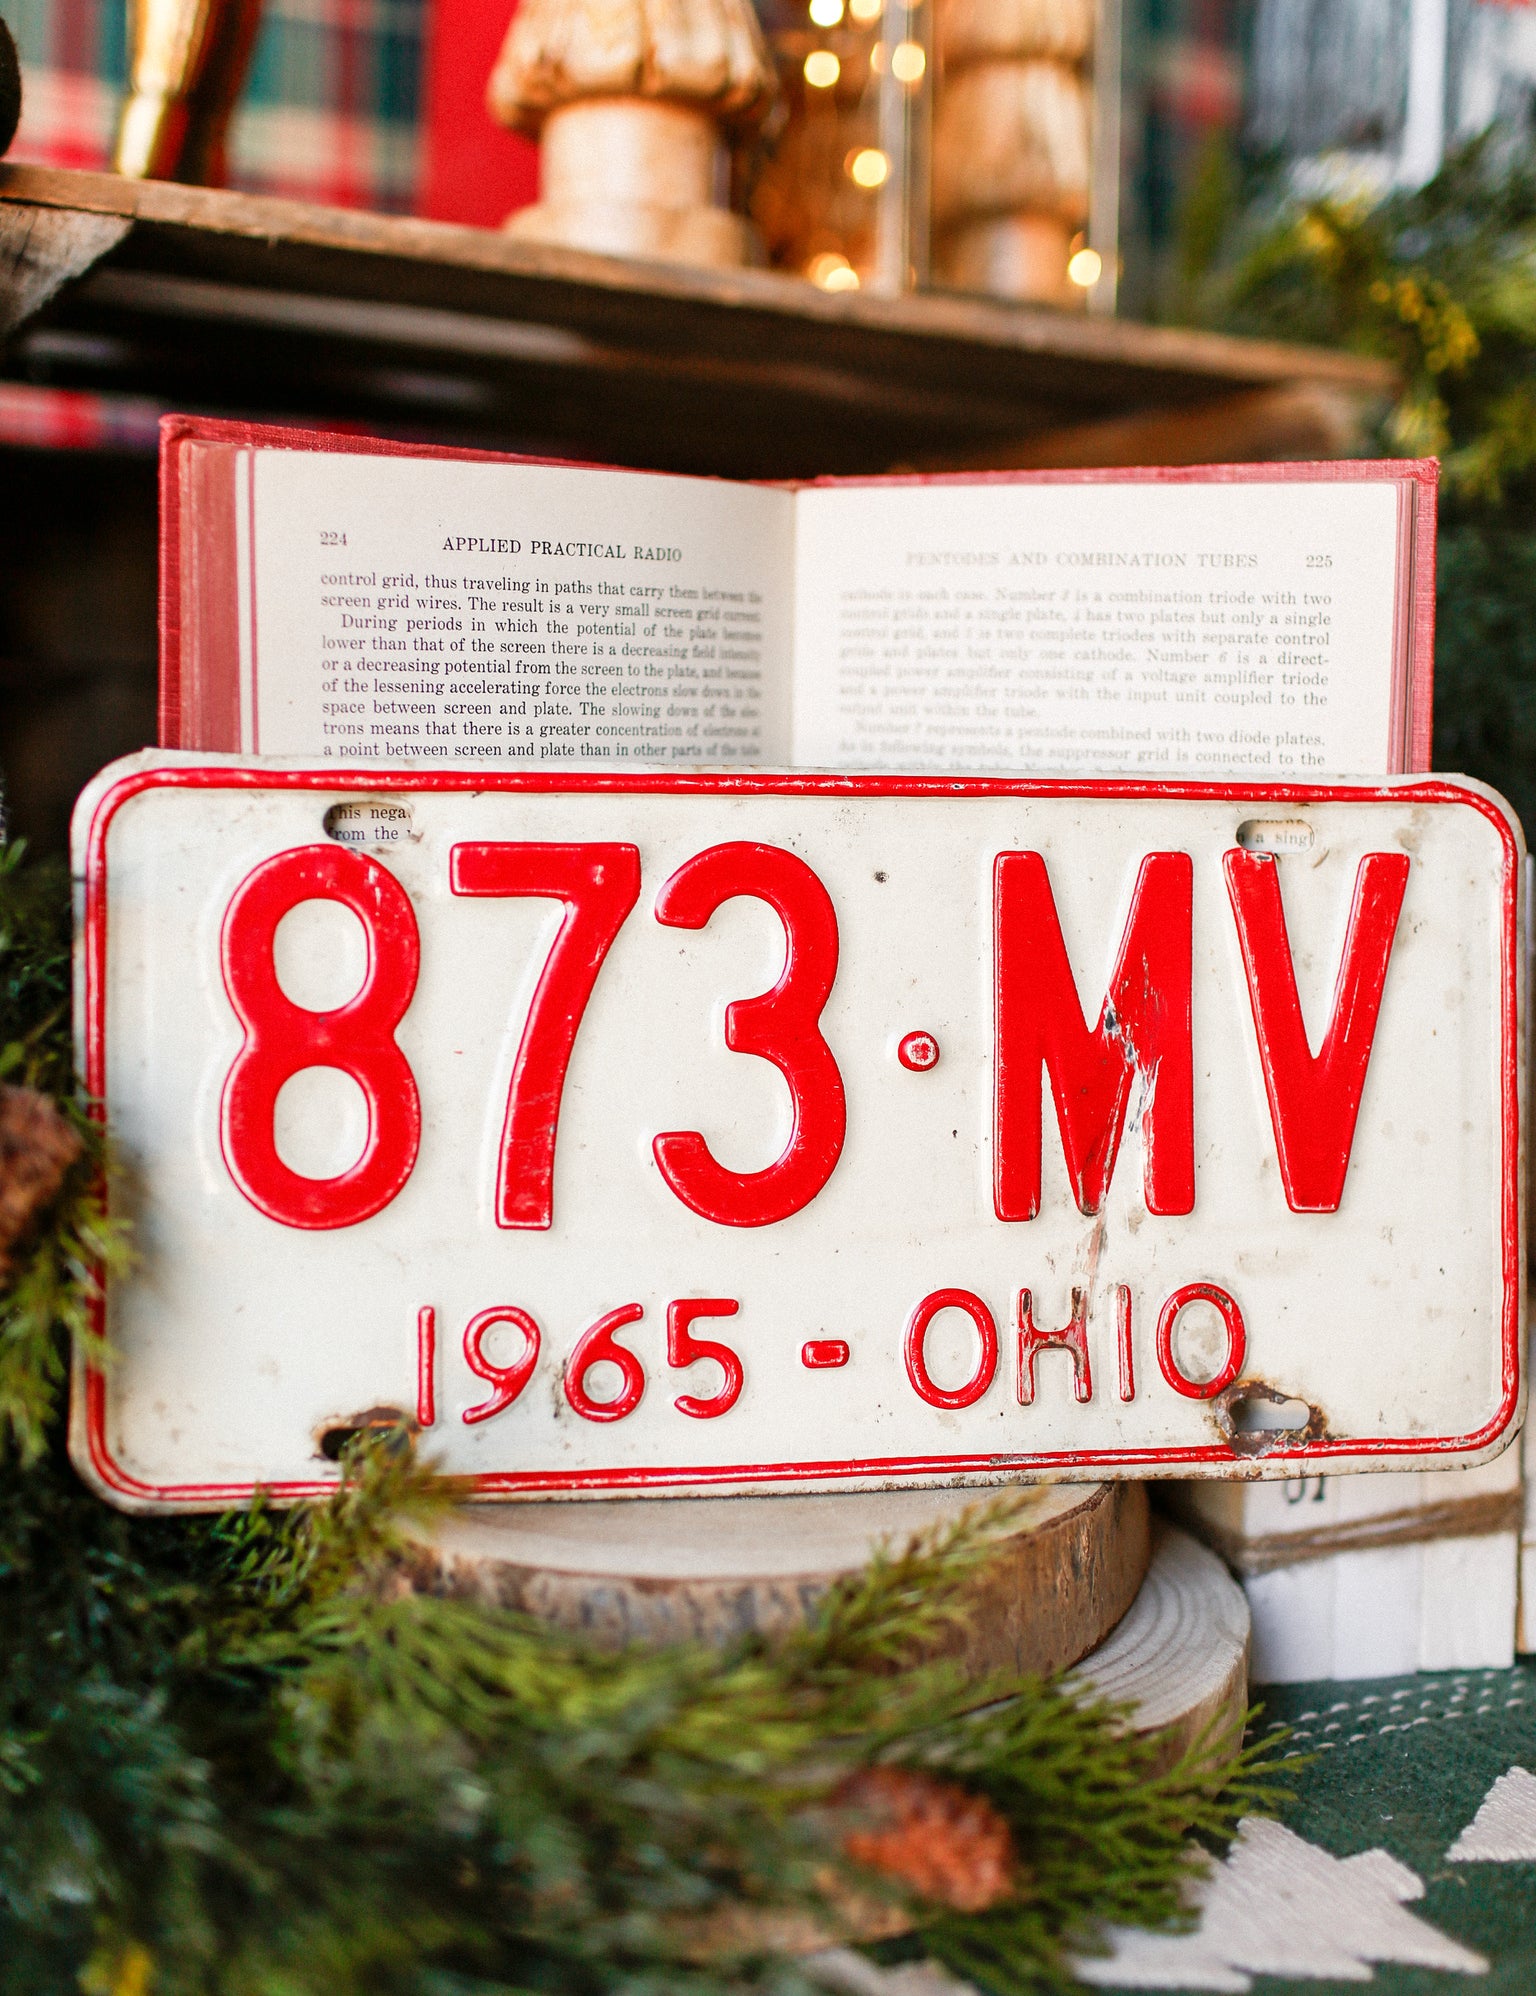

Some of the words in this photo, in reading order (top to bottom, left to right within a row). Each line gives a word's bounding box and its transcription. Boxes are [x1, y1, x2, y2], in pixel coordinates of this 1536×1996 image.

[320, 531, 348, 546] 224
[442, 537, 521, 554] APPLIED
[531, 540, 626, 558] PRACTICAL
[634, 546, 682, 562] RADIO
[1009, 553, 1048, 565] AND
[1056, 552, 1187, 568] COMBINATION
[1198, 553, 1258, 568] TUBES
[1306, 555, 1332, 568] 225
[321, 573, 376, 586] control
[382, 574, 419, 589] grid,
[424, 575, 457, 589] thus
[463, 577, 531, 594] traveling
[536, 579, 549, 592] in
[555, 580, 592, 595] paths
[598, 582, 625, 595] that
[630, 585, 664, 600] carry
[669, 584, 698, 599] them
[321, 595, 371, 606] screen
[377, 594, 409, 610] grid
[416, 596, 461, 610] wires.
[468, 597, 496, 611] The
[502, 599, 544, 613] result
[549, 600, 560, 613] is
[566, 603, 574, 613] a
[580, 603, 609, 617] very
[615, 603, 649, 617] small
[654, 608, 693, 618] screen
[1109, 590, 1202, 604] combination
[1209, 591, 1255, 604] triode
[1260, 592, 1296, 604] with
[1303, 593, 1331, 605] two
[341, 614, 398, 630] During
[407, 617, 463, 632] periods
[471, 618, 485, 631] in
[495, 619, 538, 633] which
[547, 620, 569, 633] the
[577, 622, 636, 637] potential
[643, 624, 658, 637] of
[664, 624, 683, 638] the
[1118, 611, 1145, 622] two
[1150, 610, 1196, 624] plates
[1202, 611, 1225, 623] but
[1232, 612, 1264, 626] only
[1270, 615, 1278, 624] a
[1285, 612, 1331, 627] single
[321, 635, 365, 650] lower
[373, 637, 407, 651] than
[413, 638, 444, 651] that
[450, 638, 466, 651] of
[472, 639, 494, 652] the
[500, 642, 545, 653] screen
[552, 642, 587, 655] there
[593, 642, 604, 655] is
[609, 646, 616, 655] a
[621, 643, 688, 659] decreasing
[1102, 631, 1154, 642] triodes
[1162, 630, 1196, 643] with
[1202, 632, 1269, 648] separate
[1275, 633, 1329, 645] control
[321, 660, 338, 670] or
[344, 662, 351, 671] a
[357, 657, 440, 674] decreasing
[445, 660, 511, 675] potential
[515, 660, 550, 674] from
[555, 661, 577, 675] the
[581, 664, 623, 676] screen
[628, 664, 640, 676] to
[644, 664, 663, 677] the
[1147, 650, 1209, 663] Number
[1219, 653, 1227, 663] 6
[1237, 652, 1250, 664] is
[1259, 656, 1267, 664] a
[1277, 652, 1329, 666] direct-
[1141, 669, 1196, 684] voltage
[1204, 671, 1274, 686] amplifier
[1282, 672, 1328, 685] triode
[322, 679, 339, 692] of
[344, 679, 368, 692] the
[374, 680, 445, 695] lessening
[449, 681, 540, 696] accelerating
[545, 682, 580, 695] force
[586, 683, 606, 695] the
[611, 683, 669, 696] electrons
[1128, 688, 1167, 703] input
[1176, 689, 1206, 703] unit
[1214, 690, 1272, 706] coupled
[1280, 692, 1295, 705] to
[1304, 692, 1327, 705] the
[322, 703, 365, 715] space
[373, 700, 436, 714] between
[444, 704, 492, 715] screen
[499, 702, 526, 715] and
[534, 702, 572, 717] plate.
[580, 702, 605, 716] The
[612, 703, 660, 718] slowing
[667, 704, 698, 717] down
[323, 722, 364, 735] trons
[370, 724, 419, 735] means
[426, 722, 456, 735] that
[463, 722, 502, 735] there
[508, 722, 520, 735] is
[525, 726, 533, 735] a
[540, 725, 591, 738] greater
[596, 724, 682, 736] concentration
[1081, 728, 1151, 740] combined
[1157, 727, 1191, 741] with
[1197, 729, 1225, 743] two
[1229, 730, 1271, 744] diode
[1275, 731, 1325, 746] plates.
[324, 745, 332, 755] a
[339, 743, 379, 757] point
[386, 743, 450, 756] between
[454, 746, 502, 756] screen
[508, 743, 534, 756] and
[540, 743, 574, 758] plate
[580, 744, 613, 756] than
[616, 744, 629, 756] in
[634, 744, 666, 756] other
[1137, 748, 1169, 762] grid
[1176, 748, 1189, 762] is
[1195, 749, 1271, 764] connected
[1279, 751, 1293, 765] to
[1301, 752, 1325, 766] the
[375, 825, 399, 840] the
[219, 841, 846, 1230] 873
[993, 850, 1410, 1222] MV
[416, 1298, 744, 1426] 1965
[904, 1282, 1247, 1410] OHIO
